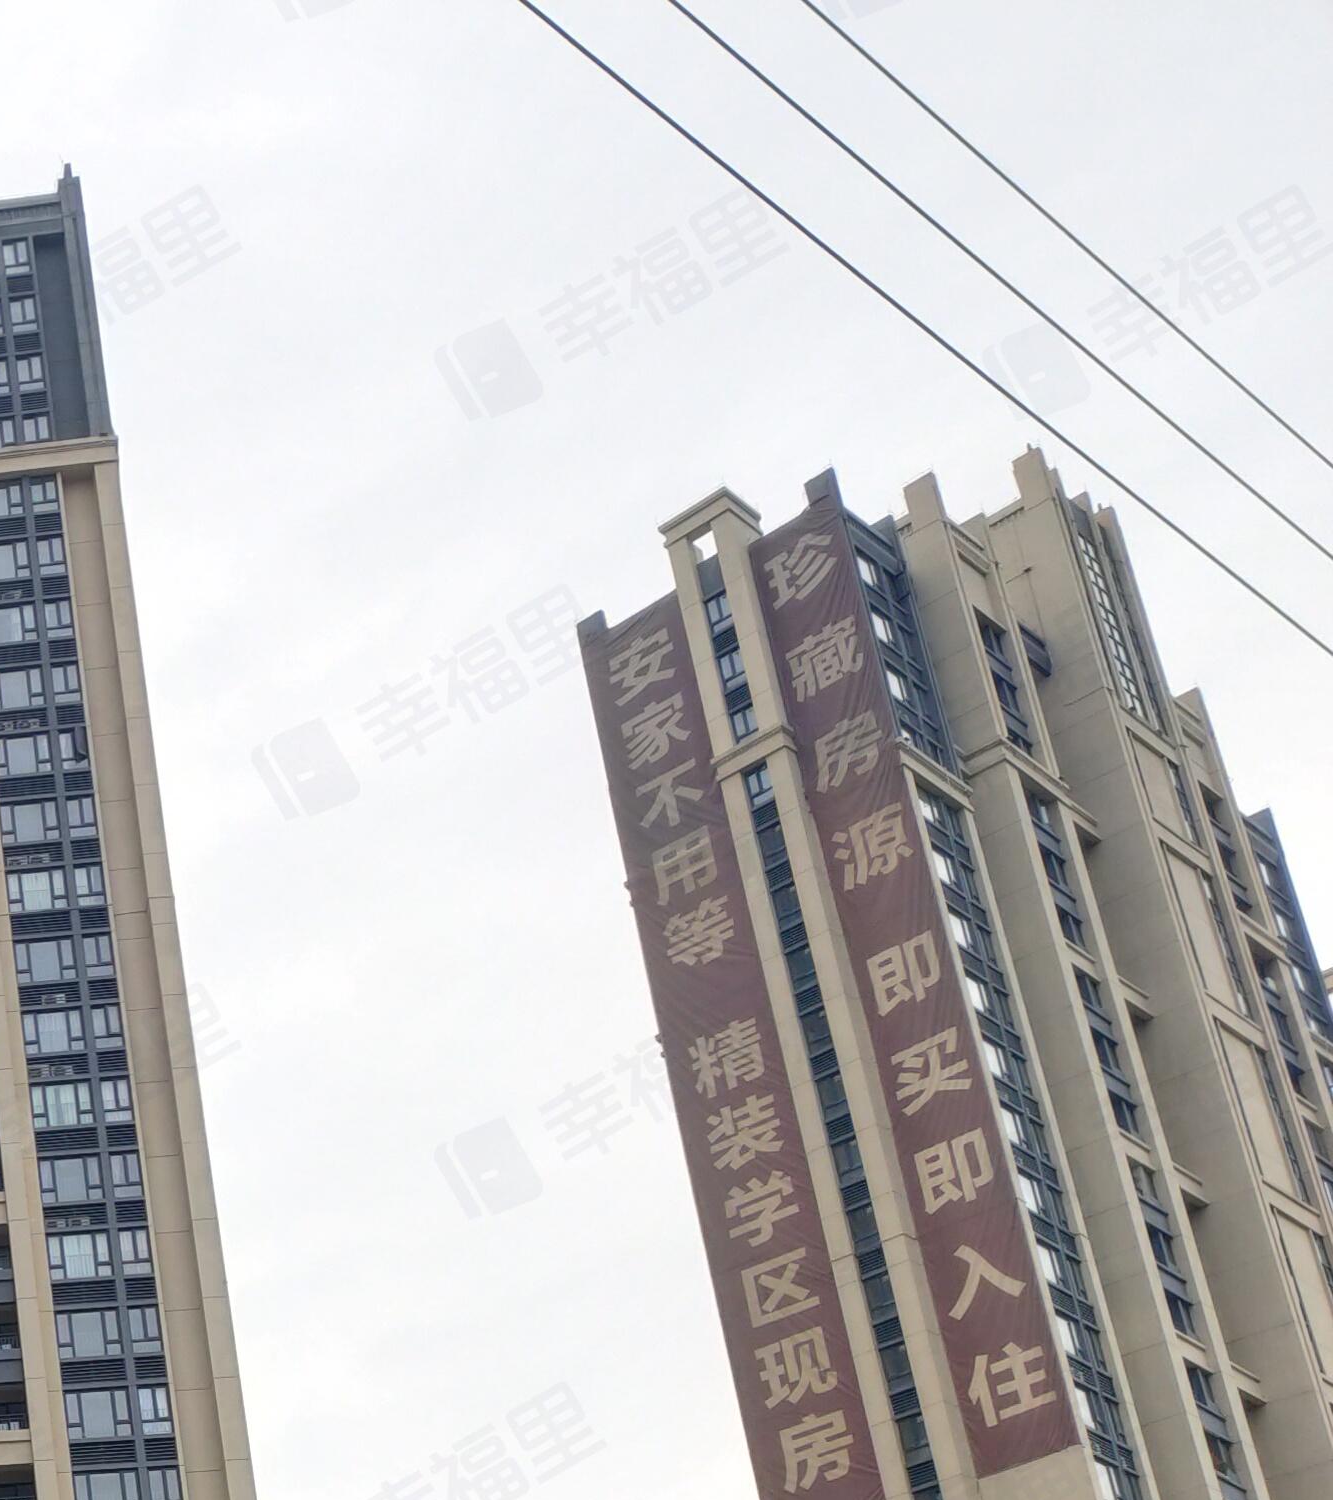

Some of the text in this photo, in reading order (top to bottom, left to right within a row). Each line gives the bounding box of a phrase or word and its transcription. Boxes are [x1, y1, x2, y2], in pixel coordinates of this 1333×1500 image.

[606, 626, 736, 968] 安家不用等
[689, 1017, 854, 1495] 精装学区现房
[761, 532, 1056, 1429] 珍藏房源 即买即入住
